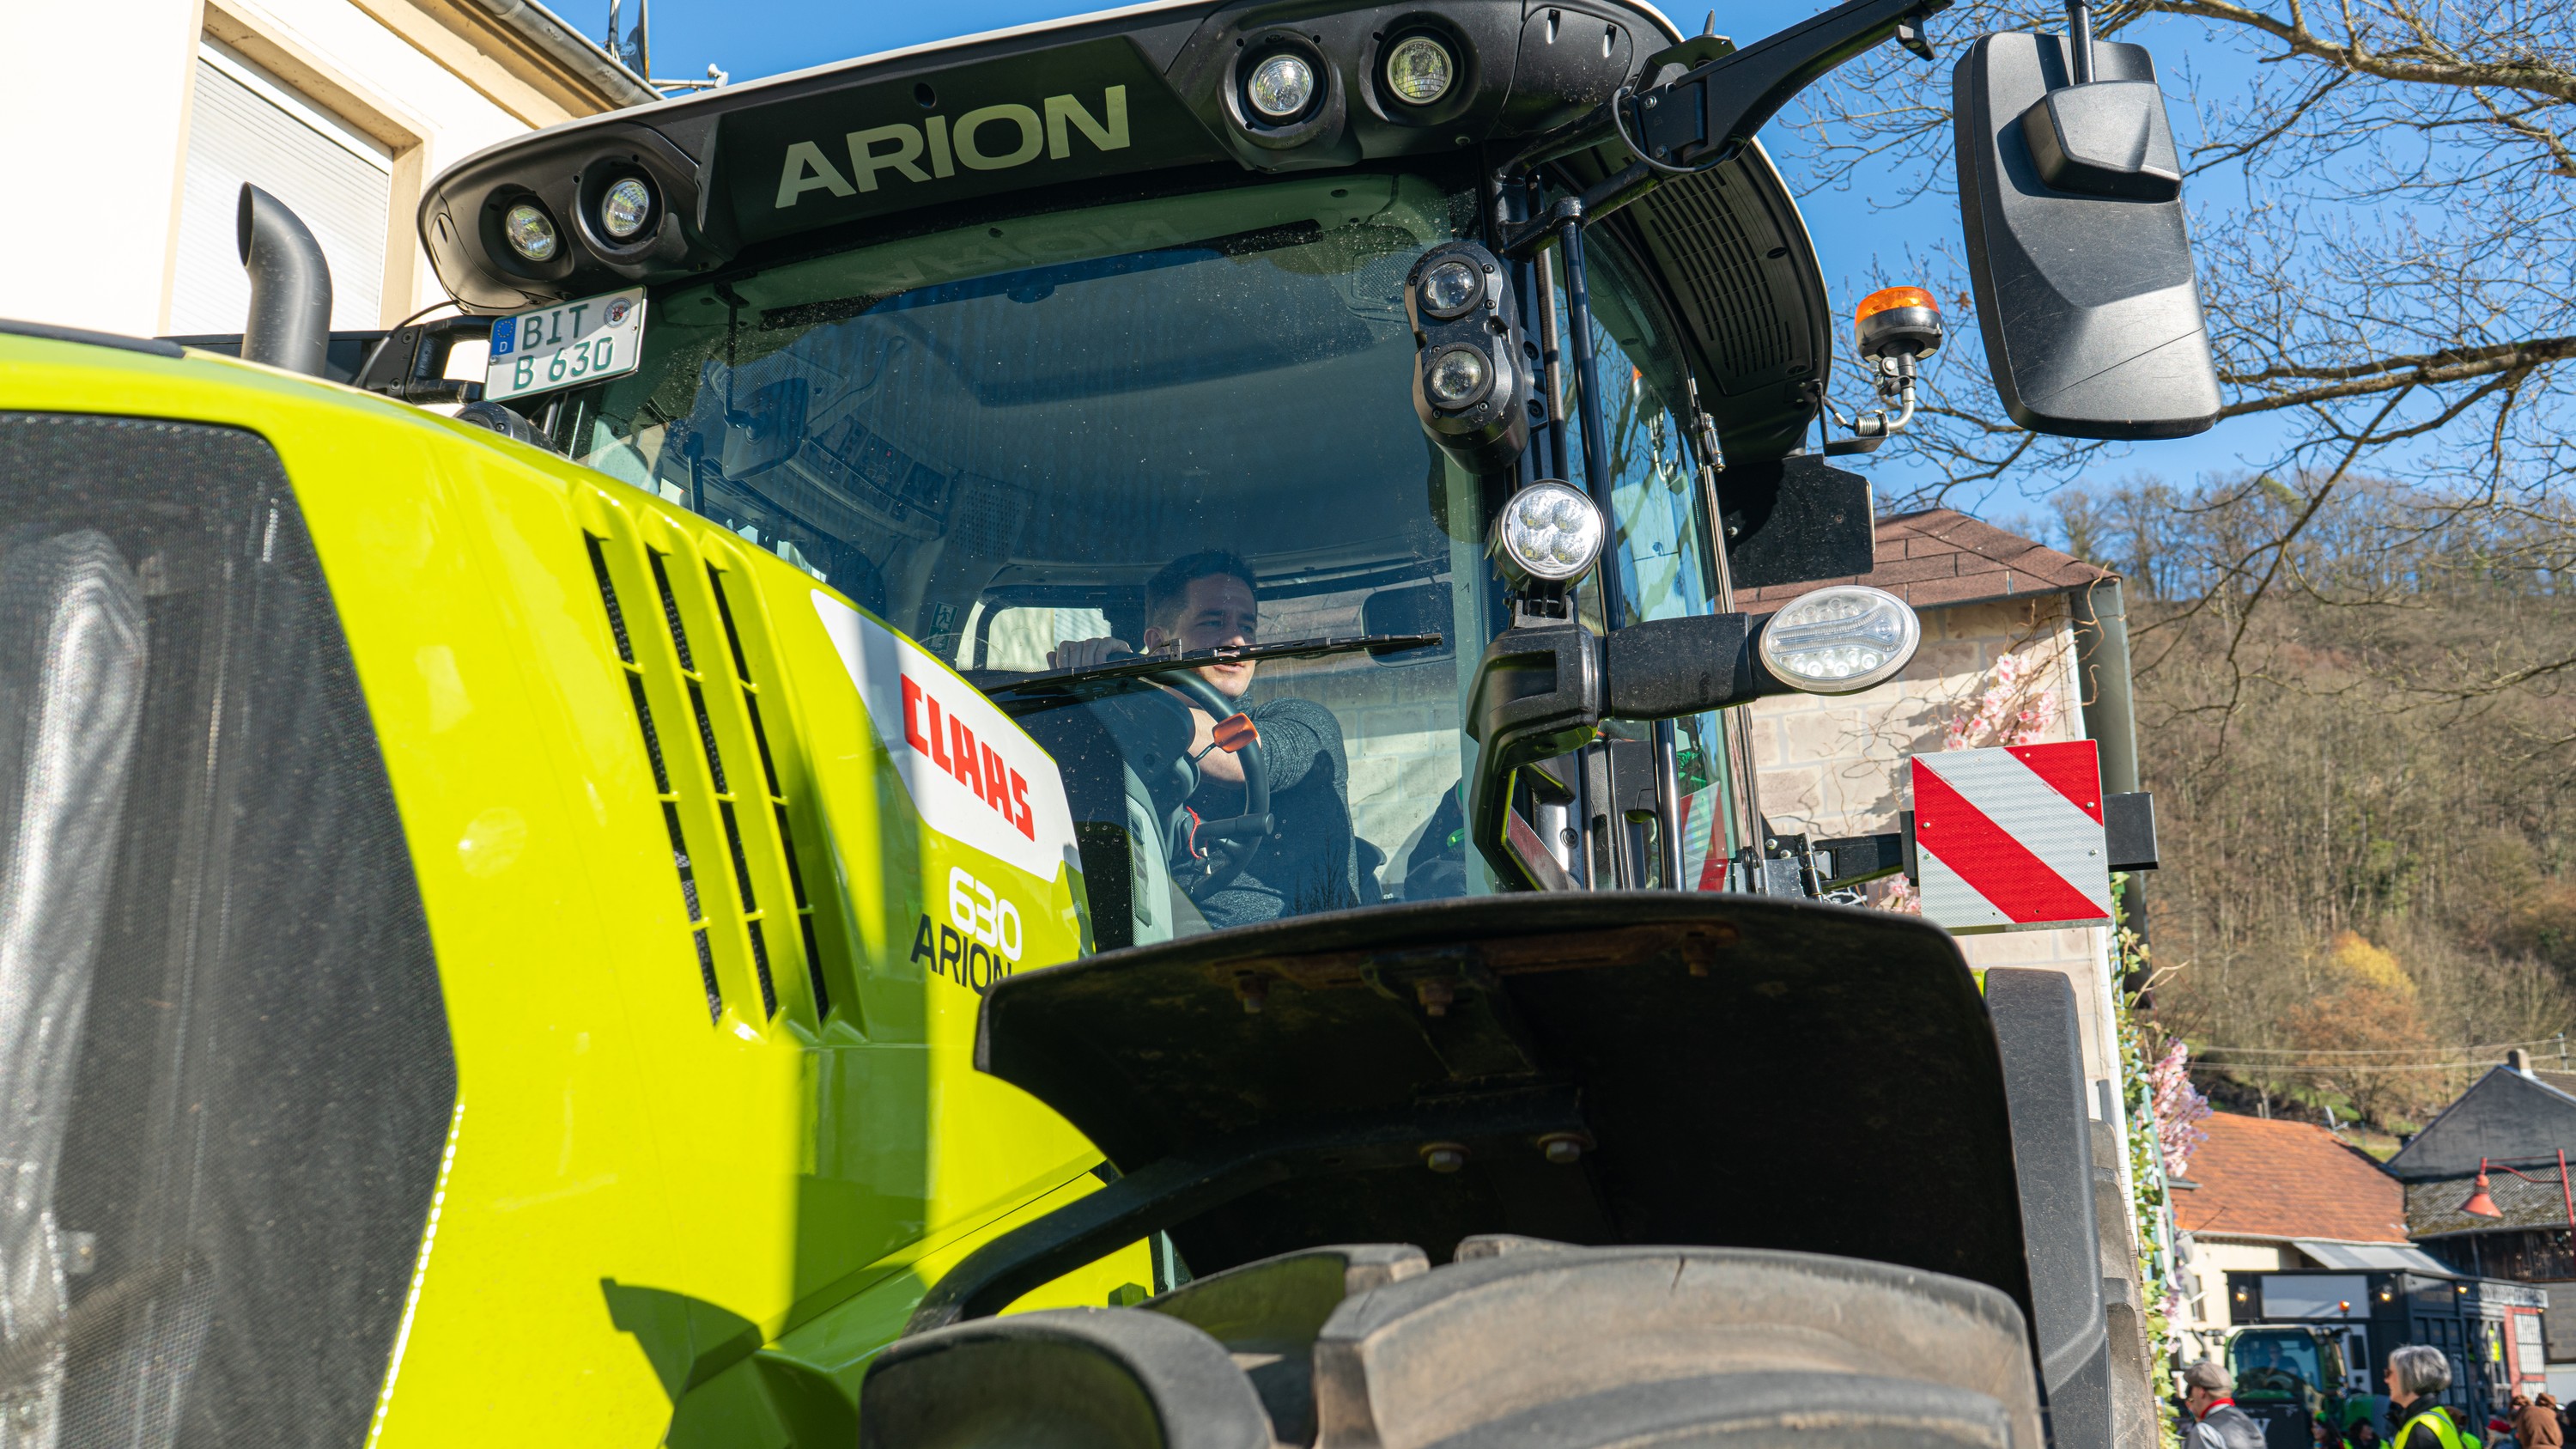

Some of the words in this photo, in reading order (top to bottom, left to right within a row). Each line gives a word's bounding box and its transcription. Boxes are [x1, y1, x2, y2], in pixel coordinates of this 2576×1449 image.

[775, 85, 1131, 208] ARION
[499, 341, 508, 352] D
[514, 355, 534, 390] B
[549, 337, 613, 381] 630
[522, 304, 588, 350] BIT
[901, 673, 1035, 842] CLAAS
[949, 867, 1022, 961] 630
